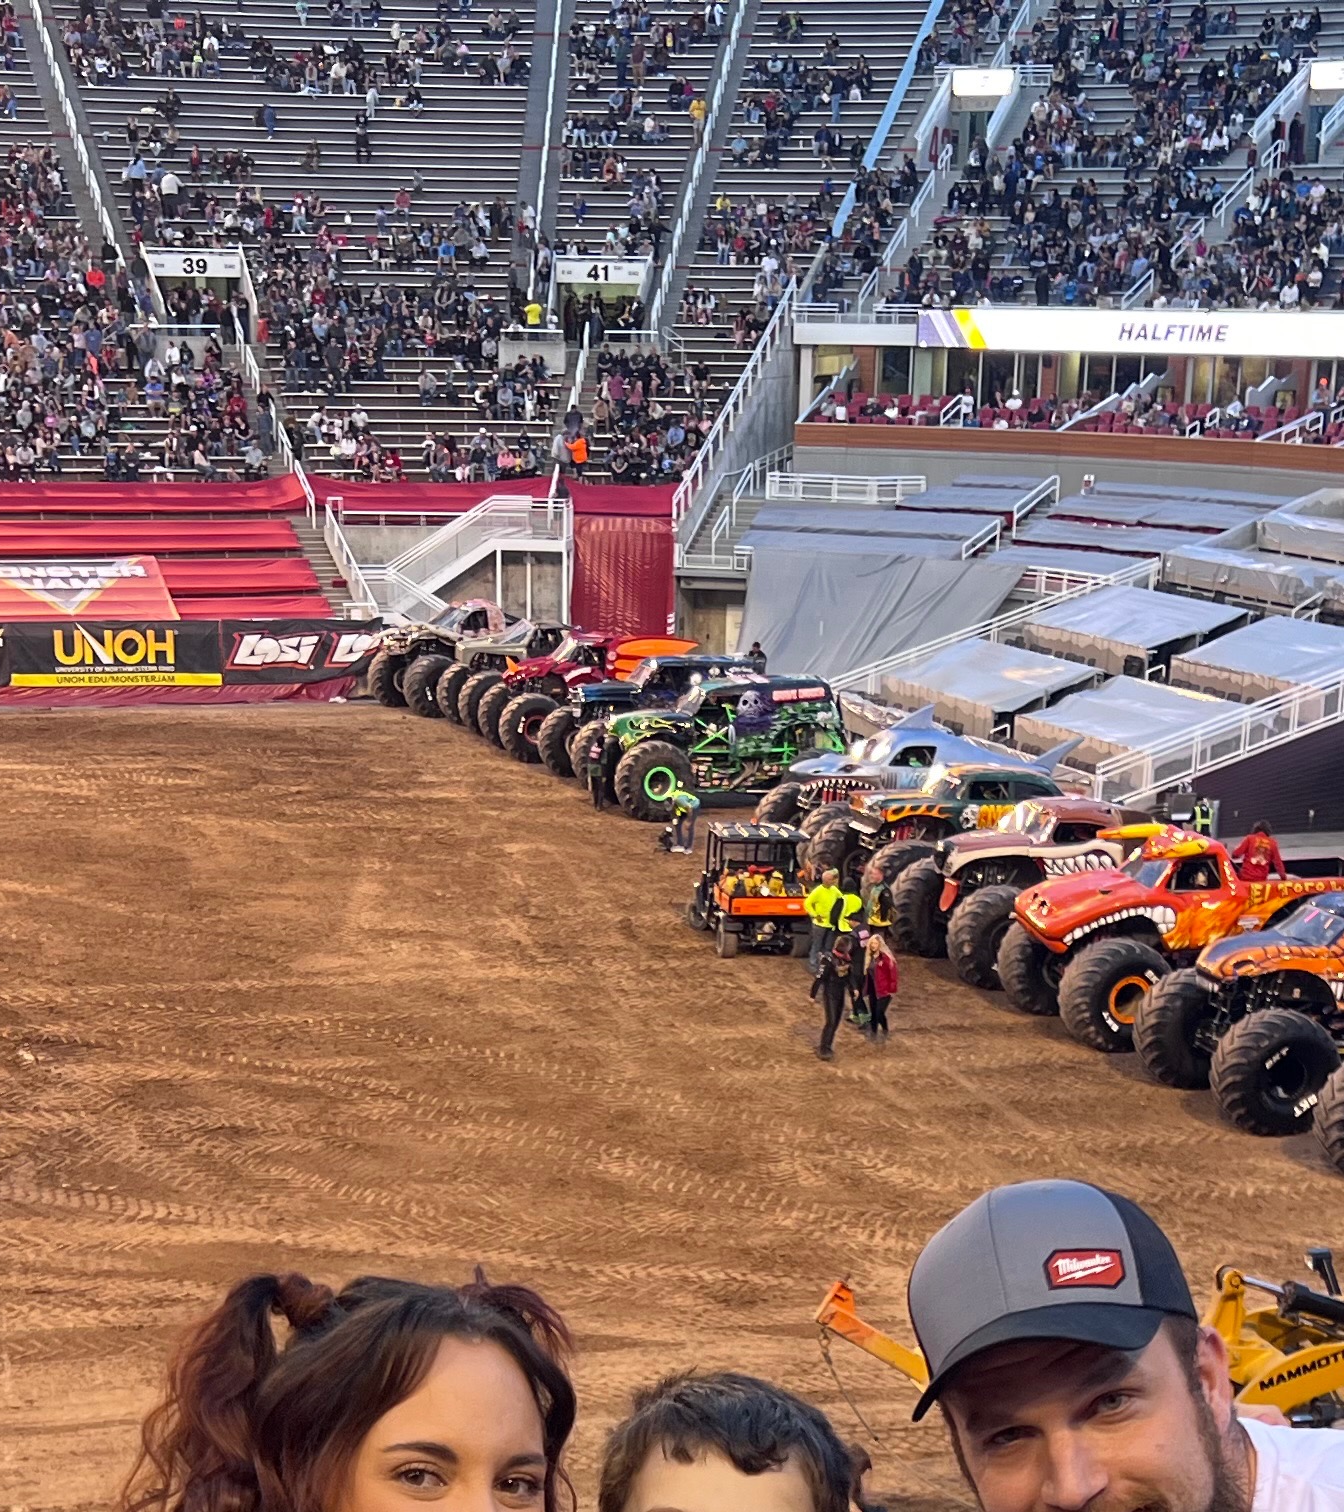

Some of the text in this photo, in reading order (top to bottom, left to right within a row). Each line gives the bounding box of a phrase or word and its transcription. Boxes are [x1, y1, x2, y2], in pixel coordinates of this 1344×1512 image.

[182, 257, 208, 275] 39
[586, 264, 609, 282] 41
[1118, 322, 1230, 342] HALFTIME
[28, 577, 104, 590] JAM
[53, 622, 175, 666] UNOH
[56, 675, 176, 684] UNOH.EDU/MONSTERJAM
